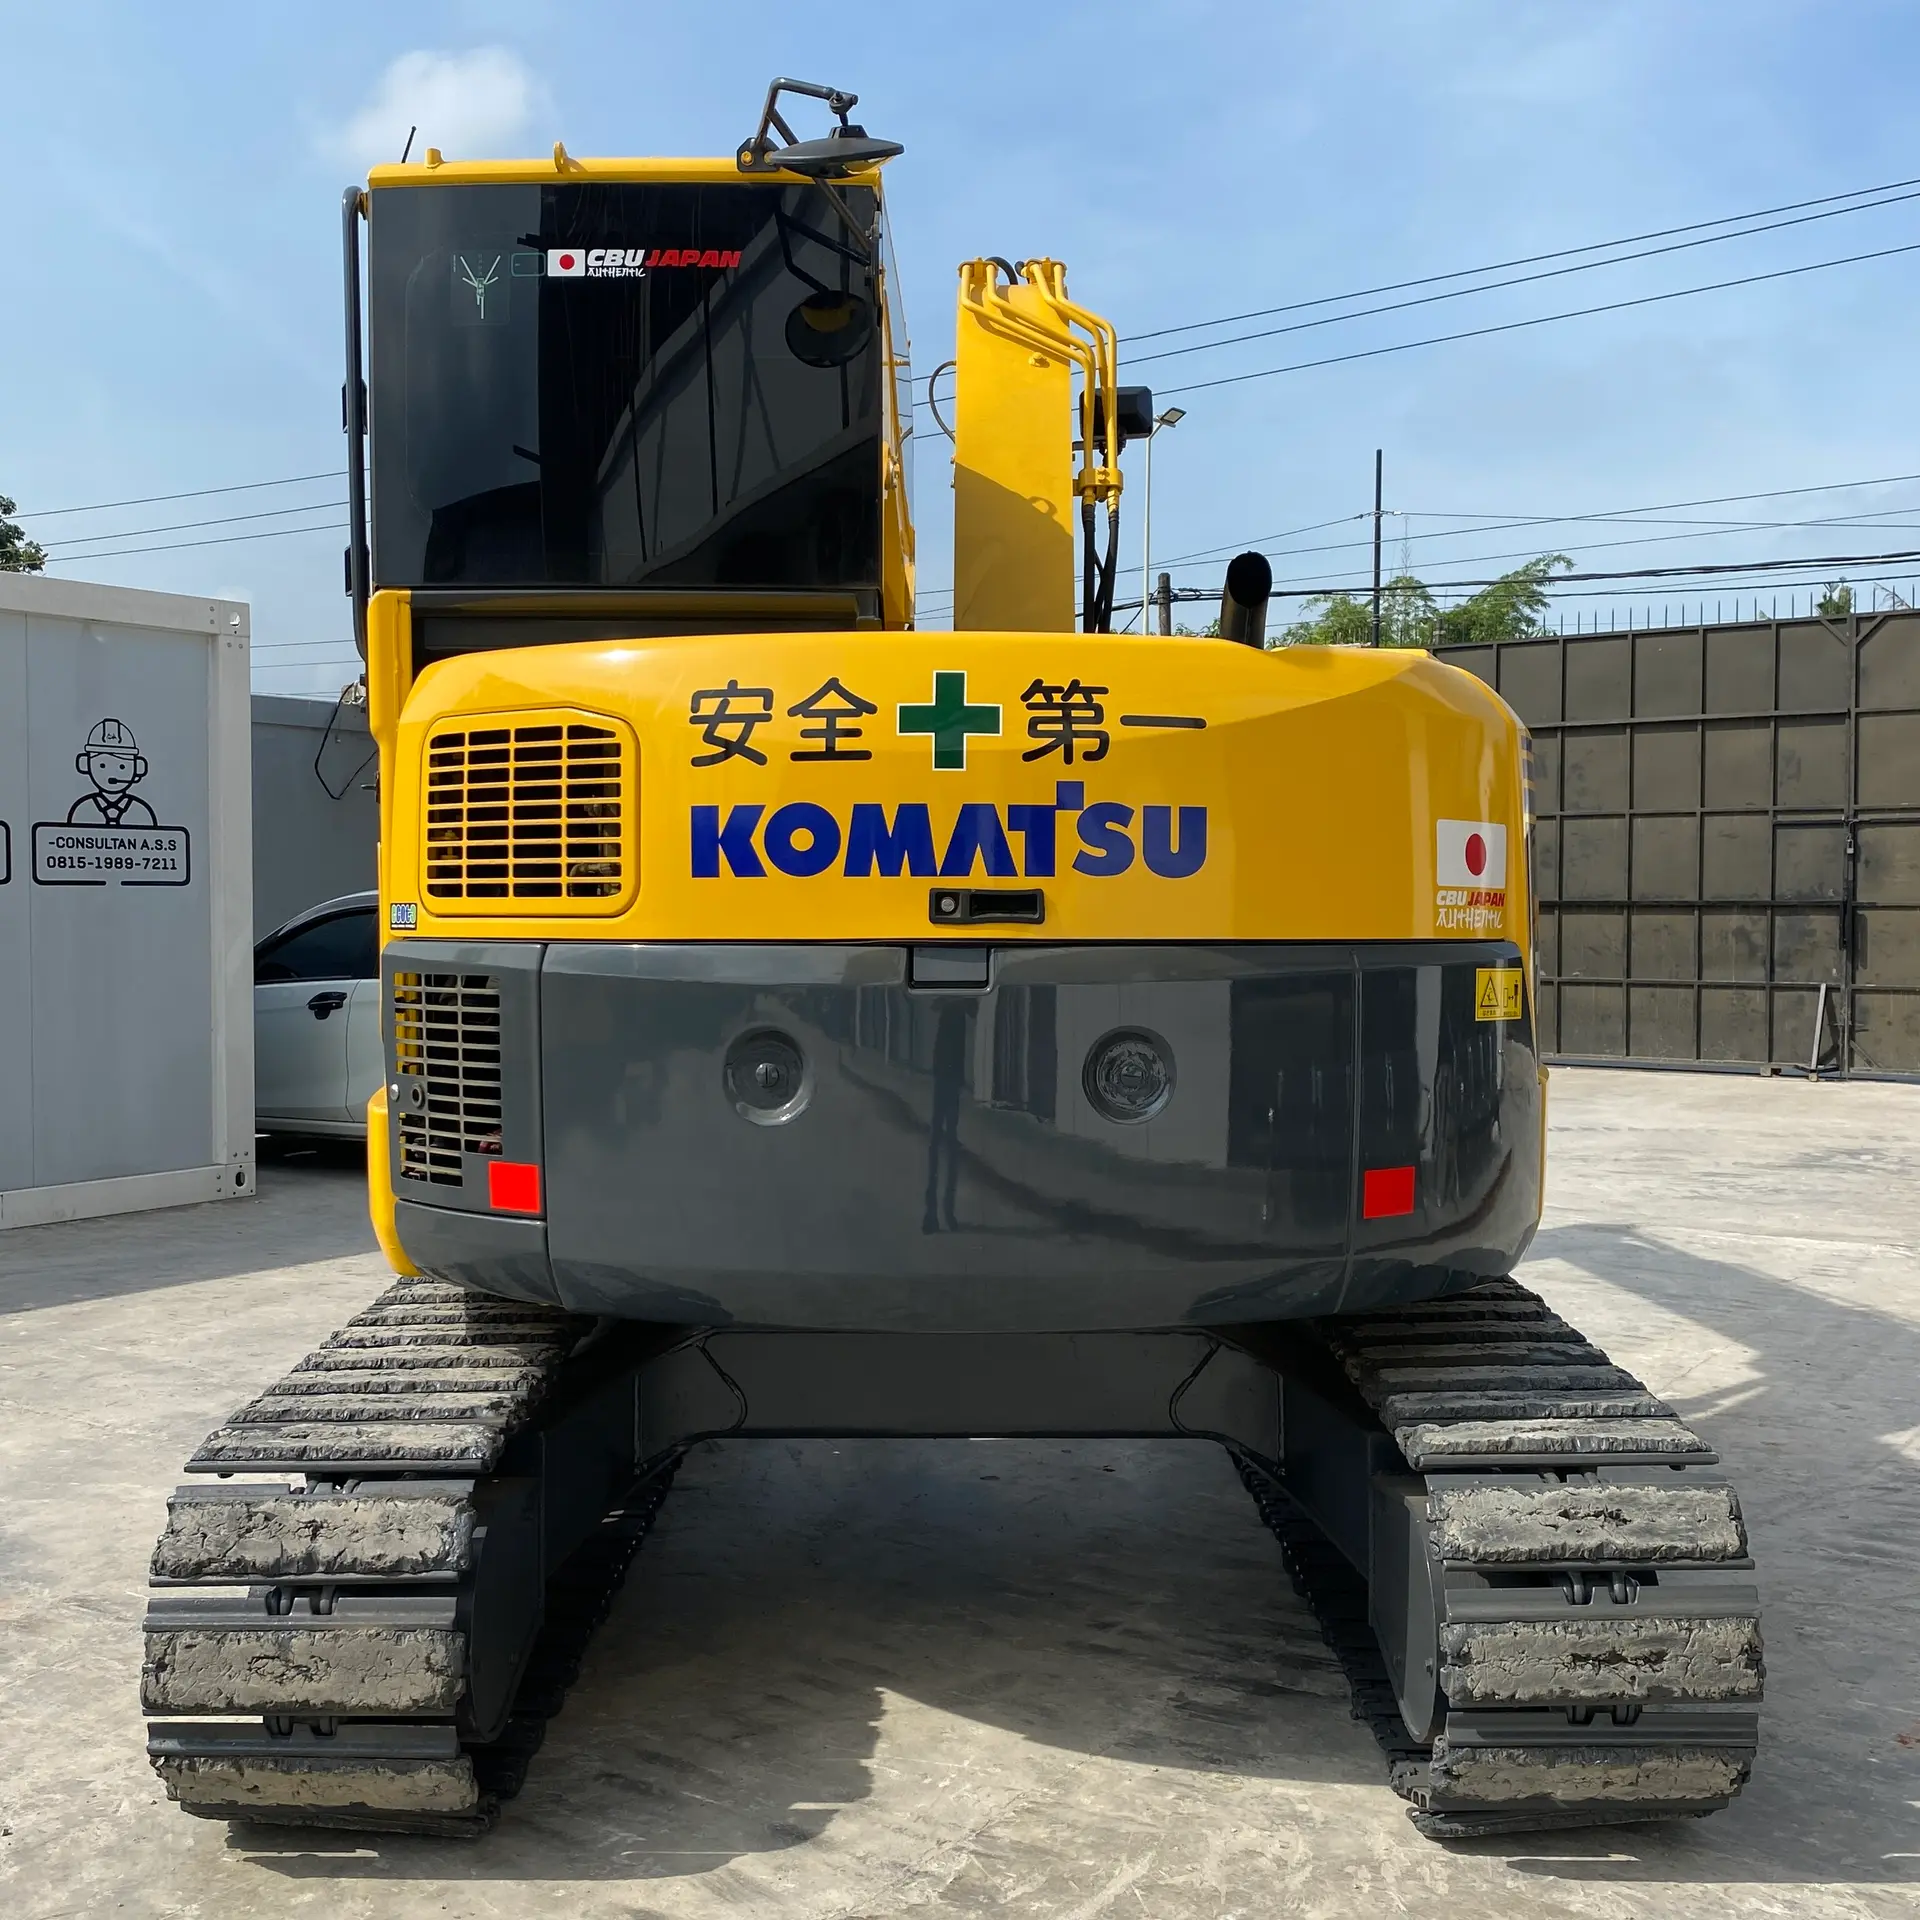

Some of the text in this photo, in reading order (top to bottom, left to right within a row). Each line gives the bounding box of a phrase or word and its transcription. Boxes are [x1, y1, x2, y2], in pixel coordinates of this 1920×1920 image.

[587, 249, 742, 268] CBU JAPAN
[586, 266, 646, 278] AUTHENTIC
[689, 677, 1207, 768] 安全 第一
[691, 780, 1207, 879] KOMATSU
[140, 839, 177, 851] A.S.S
[46, 855, 178, 870] 0815-1989-7211
[1436, 890, 1505, 907] CBU JAPAN
[1436, 907, 1503, 931] AUTHENTIC
